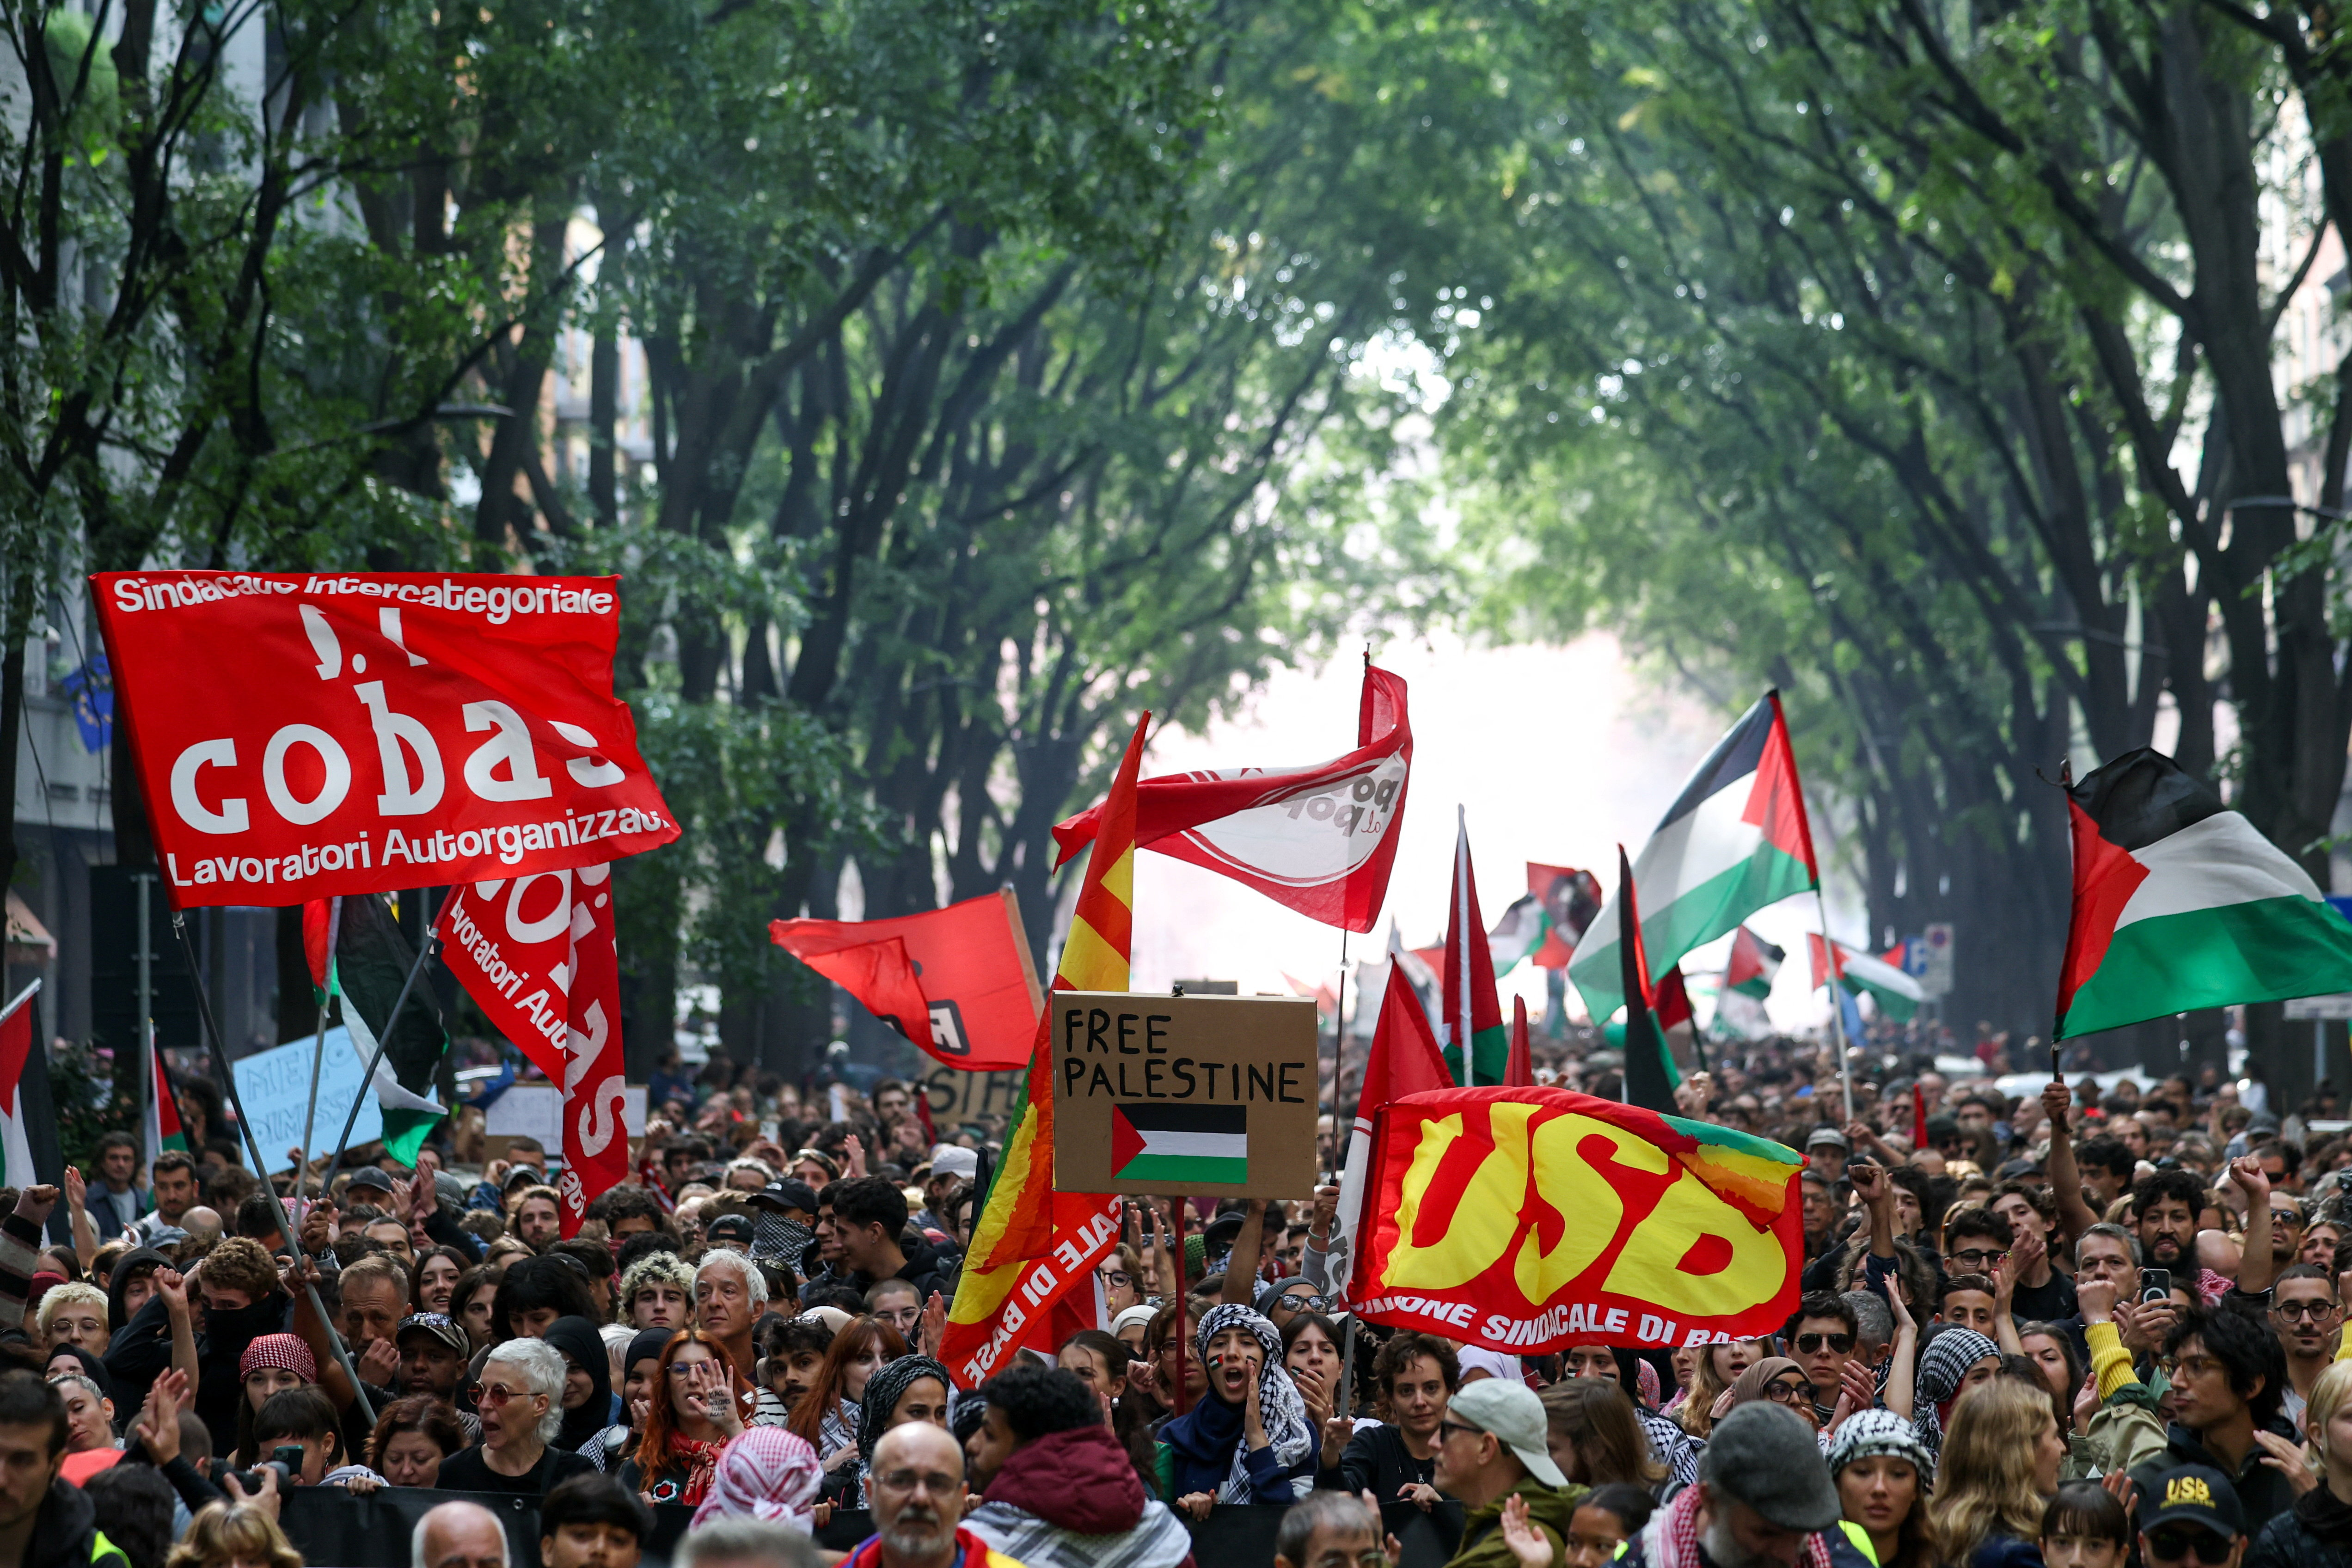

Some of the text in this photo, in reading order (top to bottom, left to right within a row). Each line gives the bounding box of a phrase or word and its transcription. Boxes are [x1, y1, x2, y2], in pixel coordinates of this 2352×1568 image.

[303, 576, 613, 625] Intercategoriale
[170, 680, 625, 834] cobas
[167, 830, 371, 887] Lavoratori
[1066, 1008, 1171, 1054] FREE
[1065, 1058, 1305, 1103] PALESTINE
[1380, 1102, 1787, 1317] USB
[1481, 1303, 1629, 1346] SINDACALE
[1636, 1314, 1677, 1344] DI
[2166, 1476, 2210, 1501] USB
